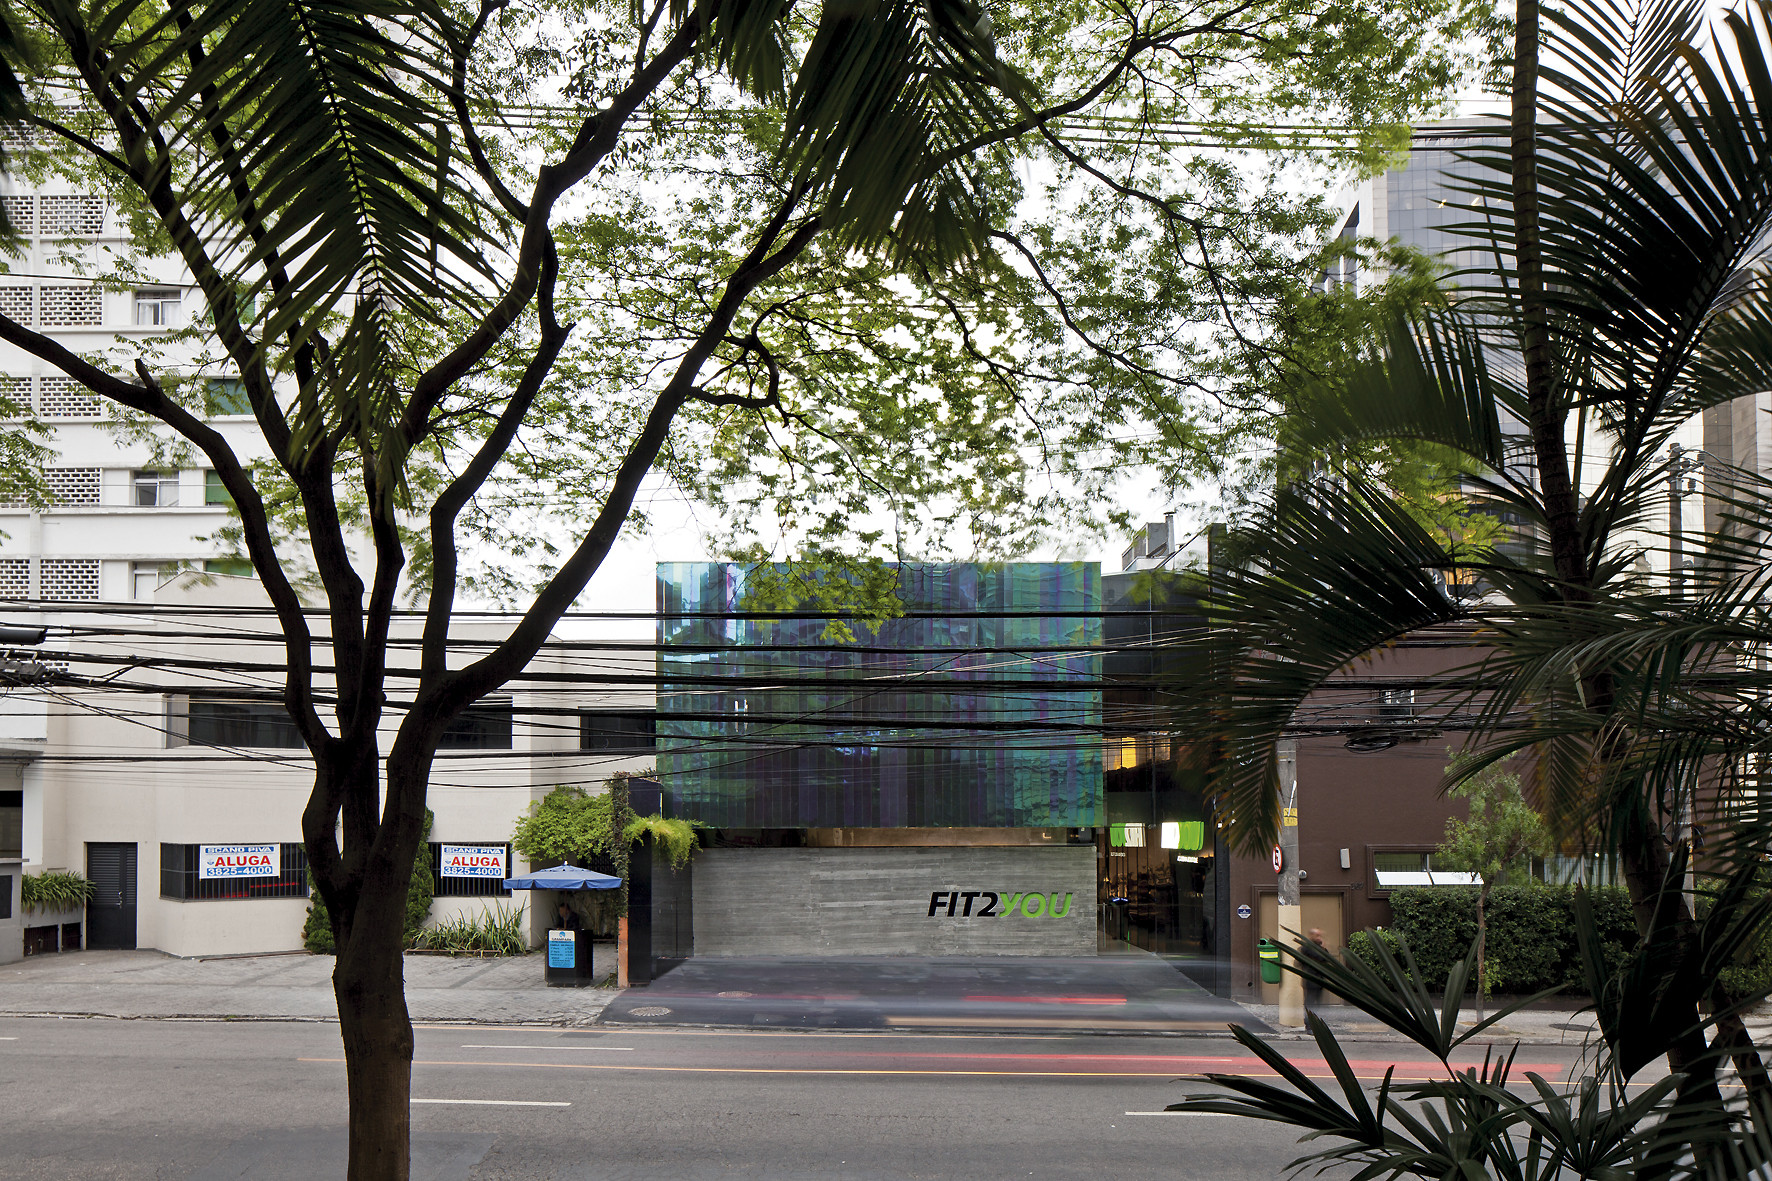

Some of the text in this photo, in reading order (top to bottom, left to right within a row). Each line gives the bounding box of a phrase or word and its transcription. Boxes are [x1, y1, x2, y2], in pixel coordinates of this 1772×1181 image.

[214, 855, 271, 867] ALUGA
[451, 856, 500, 867] ALUGA
[207, 866, 272, 876] 3825-4000
[444, 866, 501, 876] 3825-4000
[927, 891, 1073, 918] FIT2YOU
